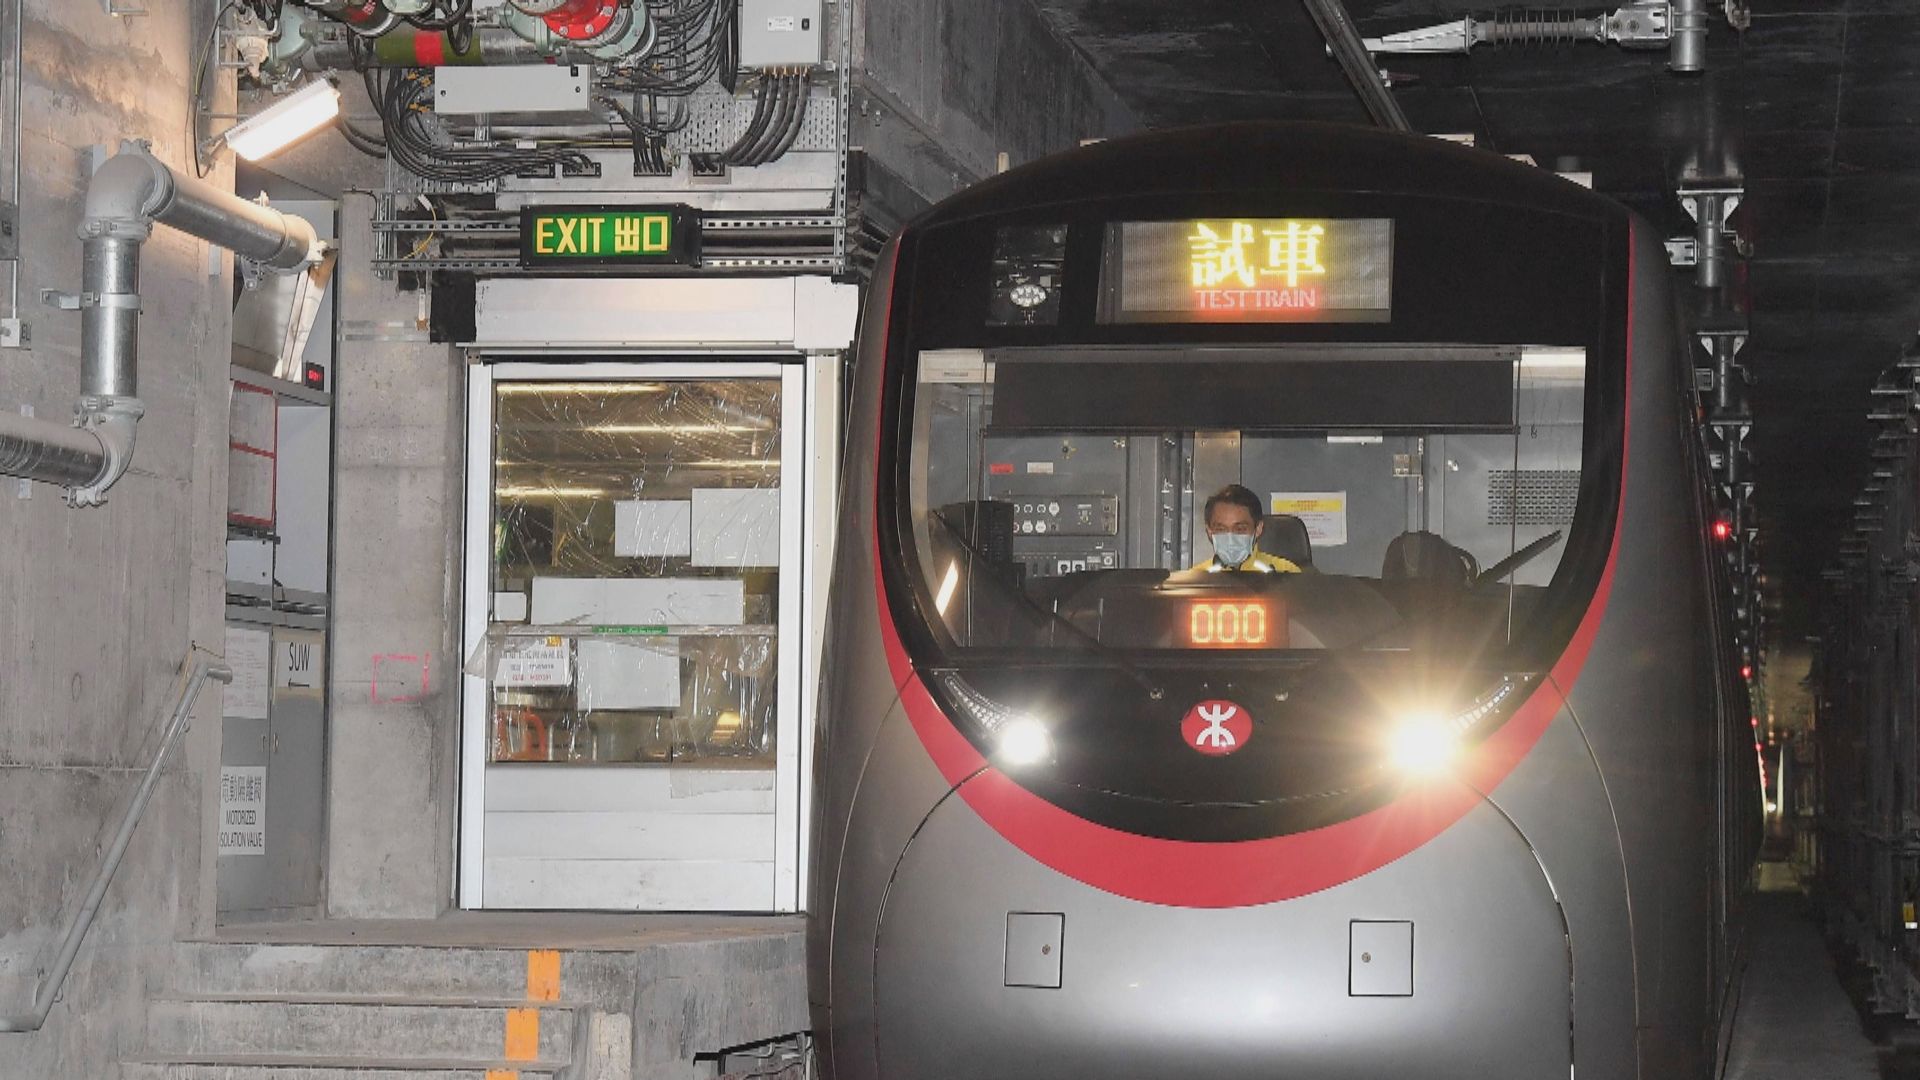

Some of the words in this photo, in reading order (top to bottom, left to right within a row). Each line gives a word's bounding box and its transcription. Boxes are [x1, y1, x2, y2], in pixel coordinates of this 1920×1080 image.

[536, 217, 606, 254] EXIT
[614, 216, 669, 254] 出口
[1187, 222, 1326, 288] 試車
[1195, 289, 1249, 309] TEST
[1251, 289, 1316, 309] TRAIN
[1191, 604, 1265, 643] 000
[288, 642, 311, 672] SUW
[225, 809, 257, 826] MOTORIZED
[219, 831, 246, 848] SOLATION
[246, 831, 263, 848] VALVE
